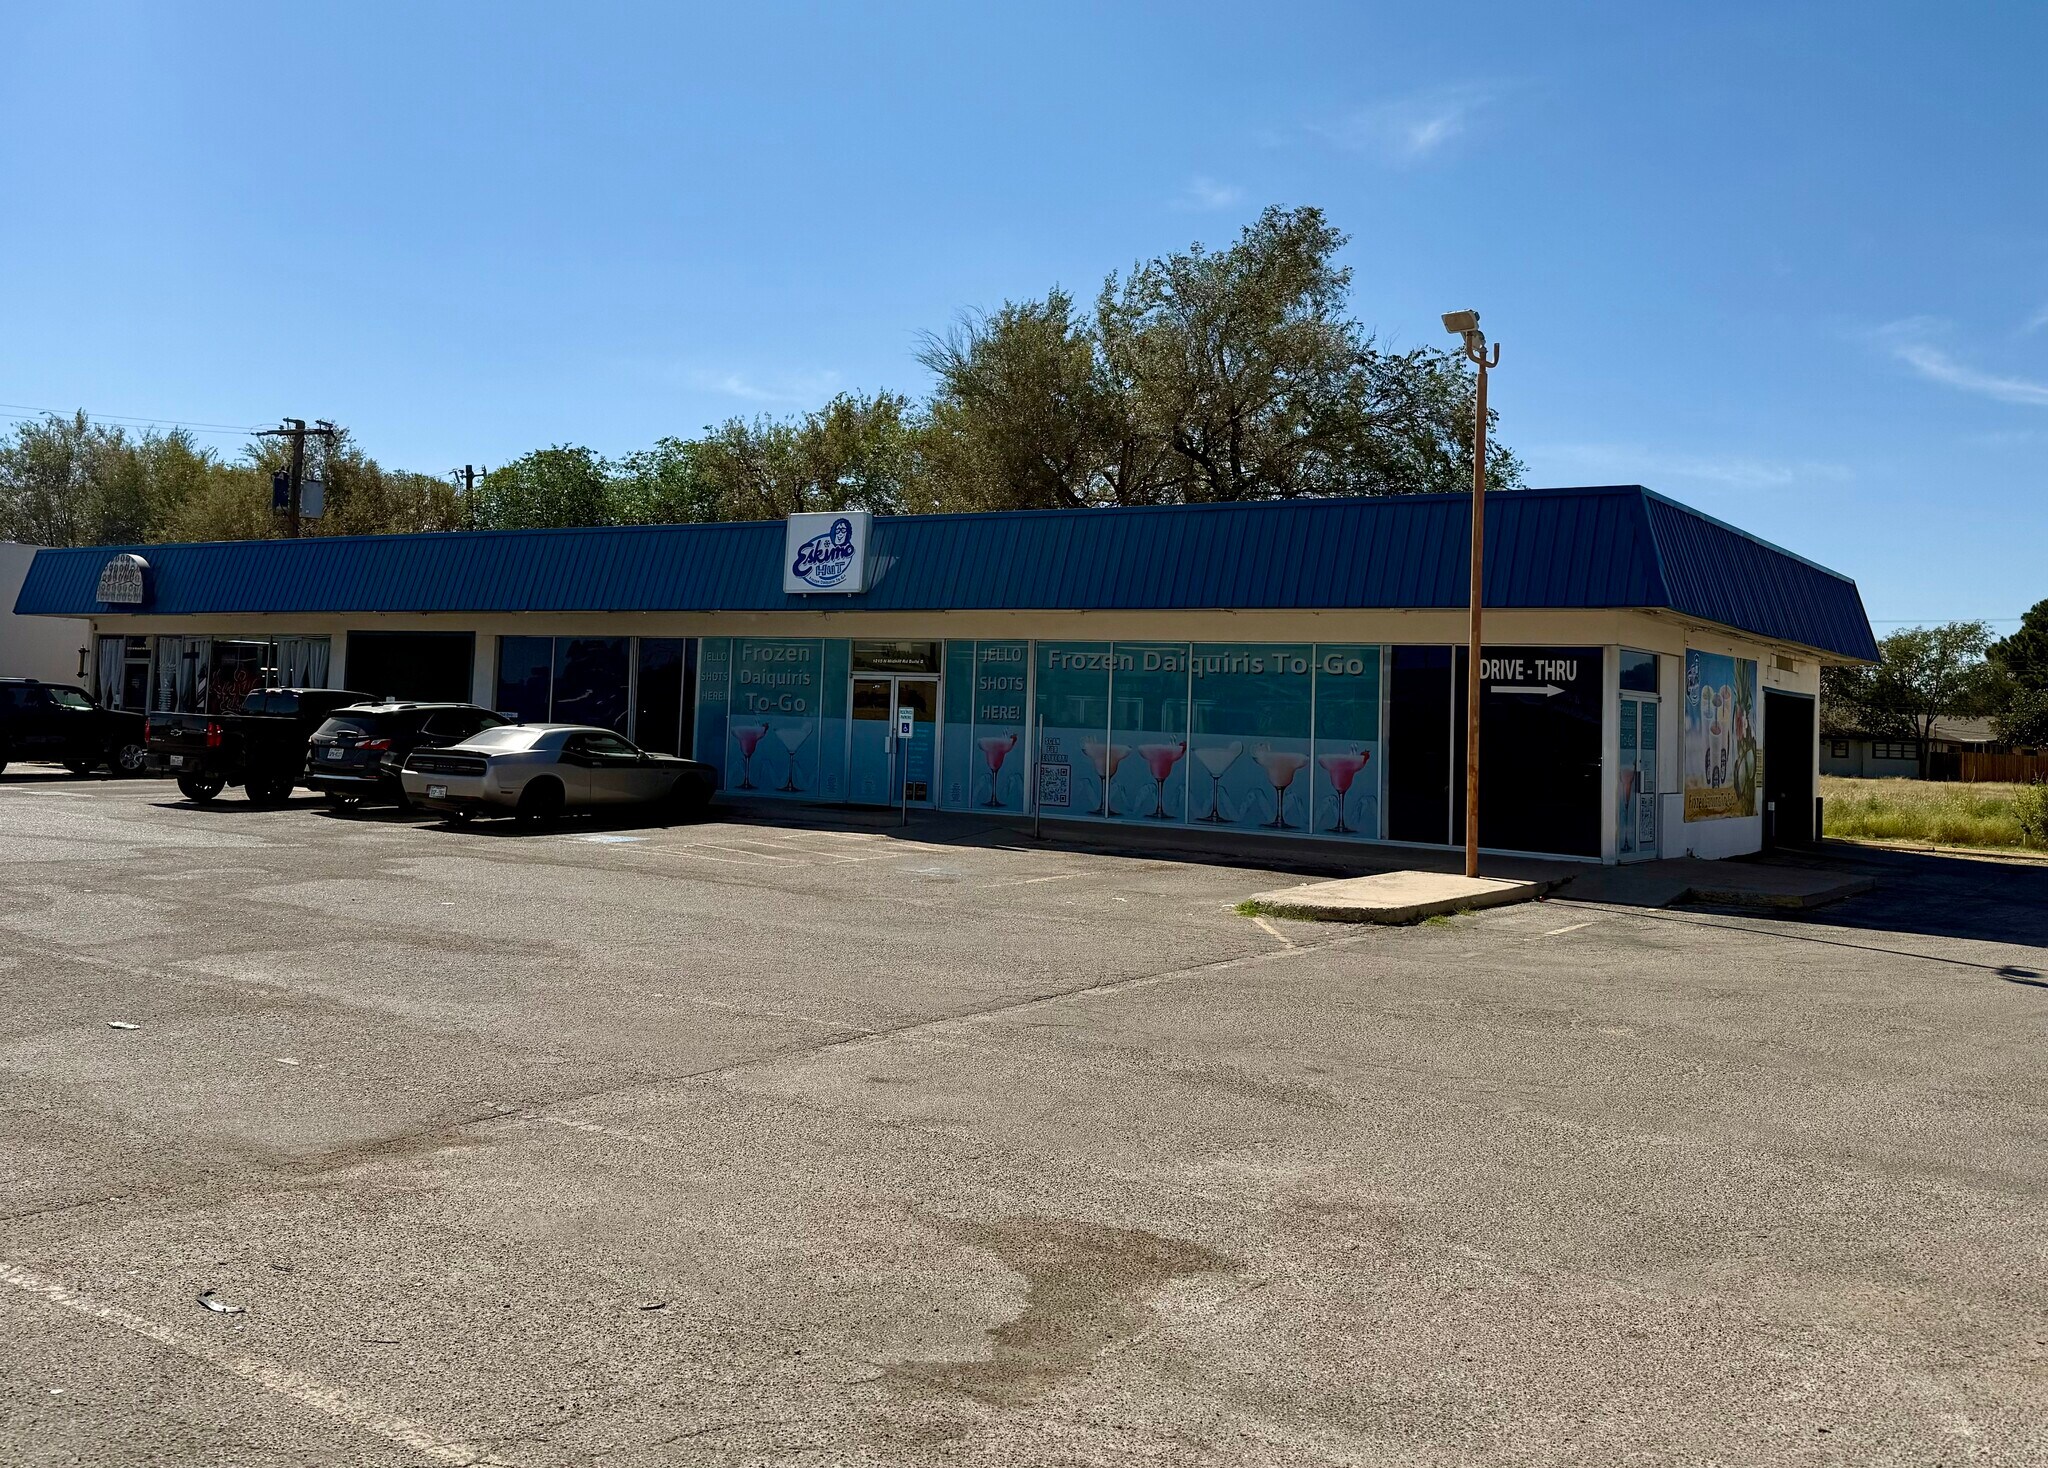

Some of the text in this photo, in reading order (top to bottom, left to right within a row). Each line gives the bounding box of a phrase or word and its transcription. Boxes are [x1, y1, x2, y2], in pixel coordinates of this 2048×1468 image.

[792, 540, 855, 577] Eskimo
[703, 651, 728, 662] JELLO
[741, 644, 810, 662] Frozen
[983, 647, 1022, 663] JELLO
[1048, 650, 1365, 679] Frozen Daiquiris To-Go
[1480, 659, 1524, 680] DRIVE
[1535, 659, 1577, 681] THRU
[701, 671, 729, 682] SHOTS
[740, 668, 811, 688] Daiquiris
[979, 676, 1024, 691] SHOTS
[745, 692, 806, 712] To-Go
[981, 705, 1021, 720] HERE!
